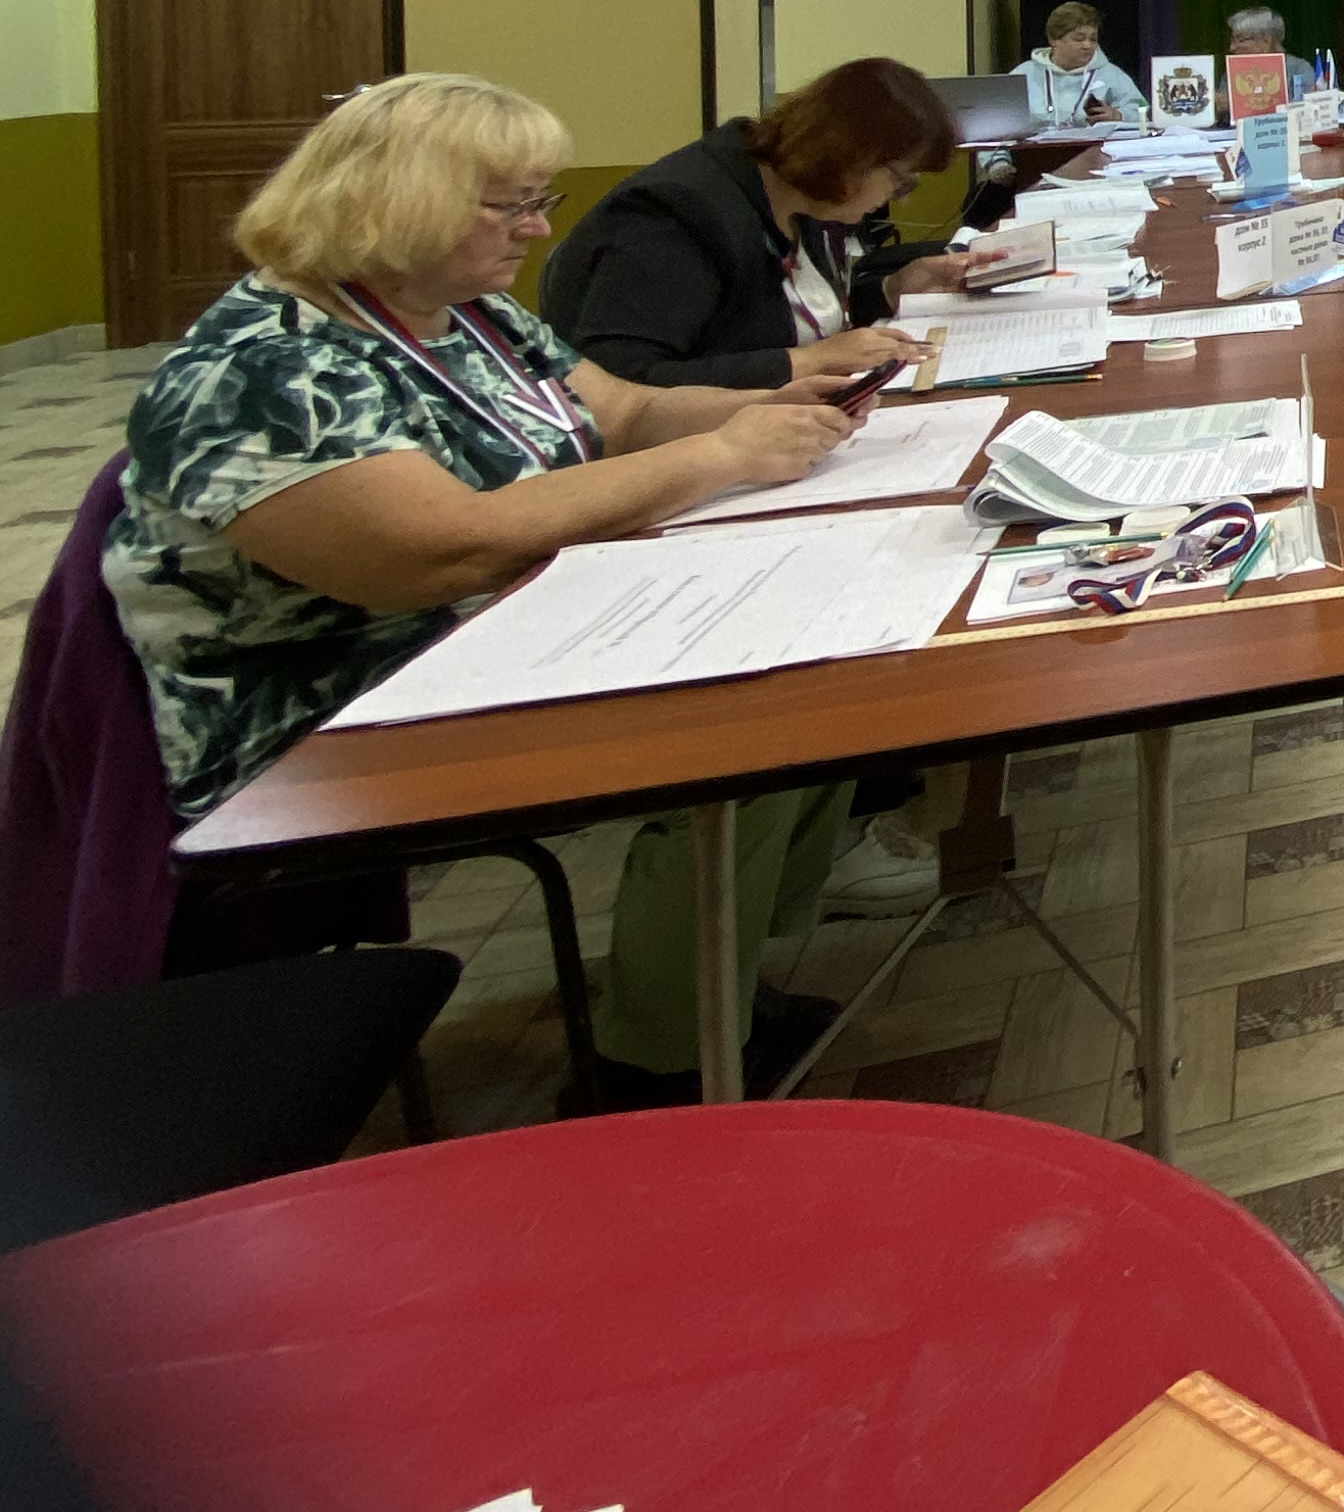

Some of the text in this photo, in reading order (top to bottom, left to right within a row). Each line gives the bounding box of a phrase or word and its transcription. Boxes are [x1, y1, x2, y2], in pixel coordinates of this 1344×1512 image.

[1251, 221, 1259, 231] №
[1238, 235, 1266, 253] корпус 2
